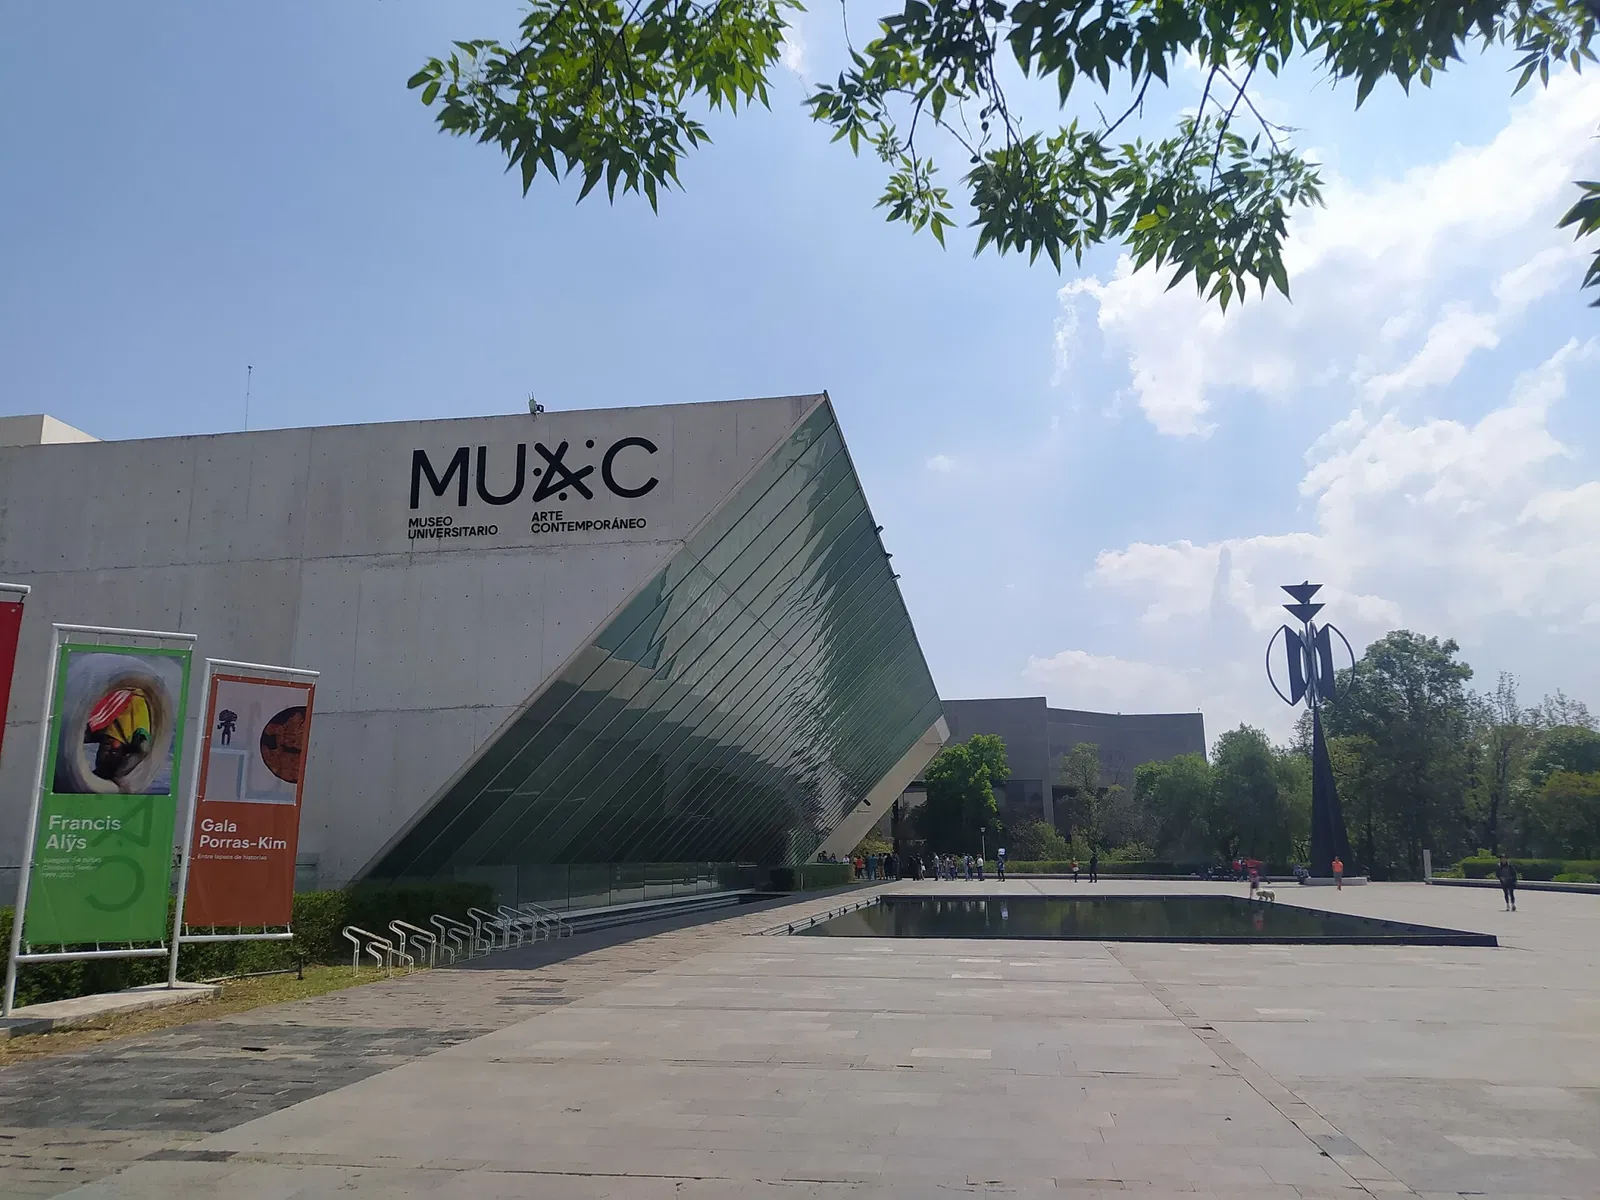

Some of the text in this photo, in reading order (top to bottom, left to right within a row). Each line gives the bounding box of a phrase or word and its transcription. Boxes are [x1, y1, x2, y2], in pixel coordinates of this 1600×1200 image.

[408, 516, 453, 528] MUSEO
[531, 511, 563, 522] ARTE
[408, 525, 498, 539] UNIVERSITARIO
[531, 517, 647, 533] CONTEMPORÁNEO
[49, 815, 121, 830] Francis
[201, 818, 237, 832] Gala
[45, 834, 87, 852] Alÿs
[200, 835, 287, 849] Porras-Kim
